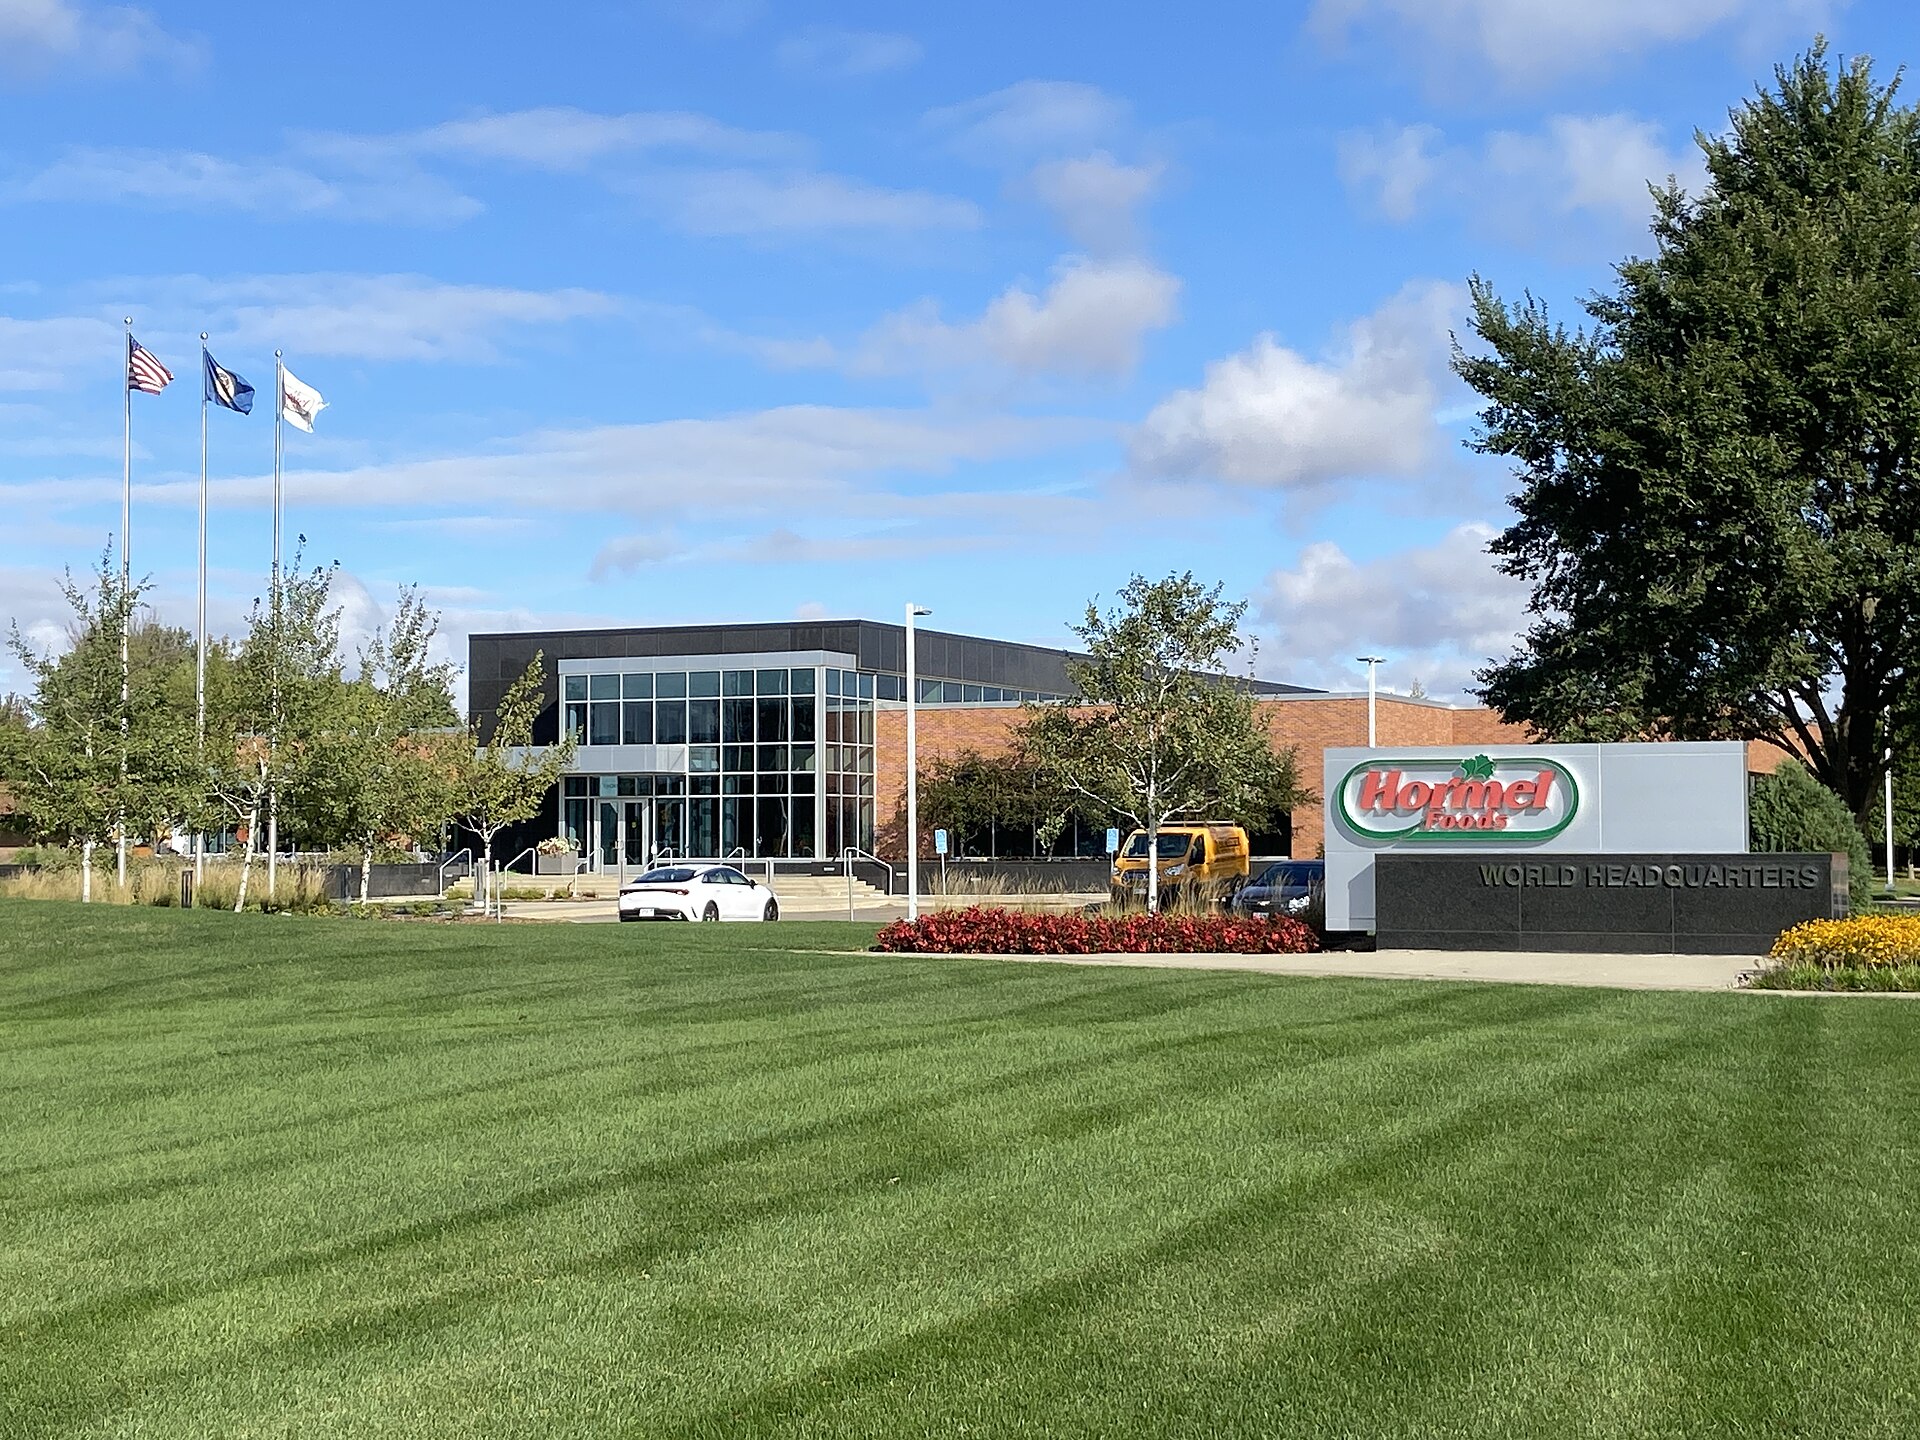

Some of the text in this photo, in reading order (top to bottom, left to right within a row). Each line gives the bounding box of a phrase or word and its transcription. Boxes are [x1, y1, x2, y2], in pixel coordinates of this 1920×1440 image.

[1359, 769, 1556, 810] Hormel
[1424, 809, 1508, 830] Foods
[1480, 864, 1819, 888] WORLD HEADQUARTERS
